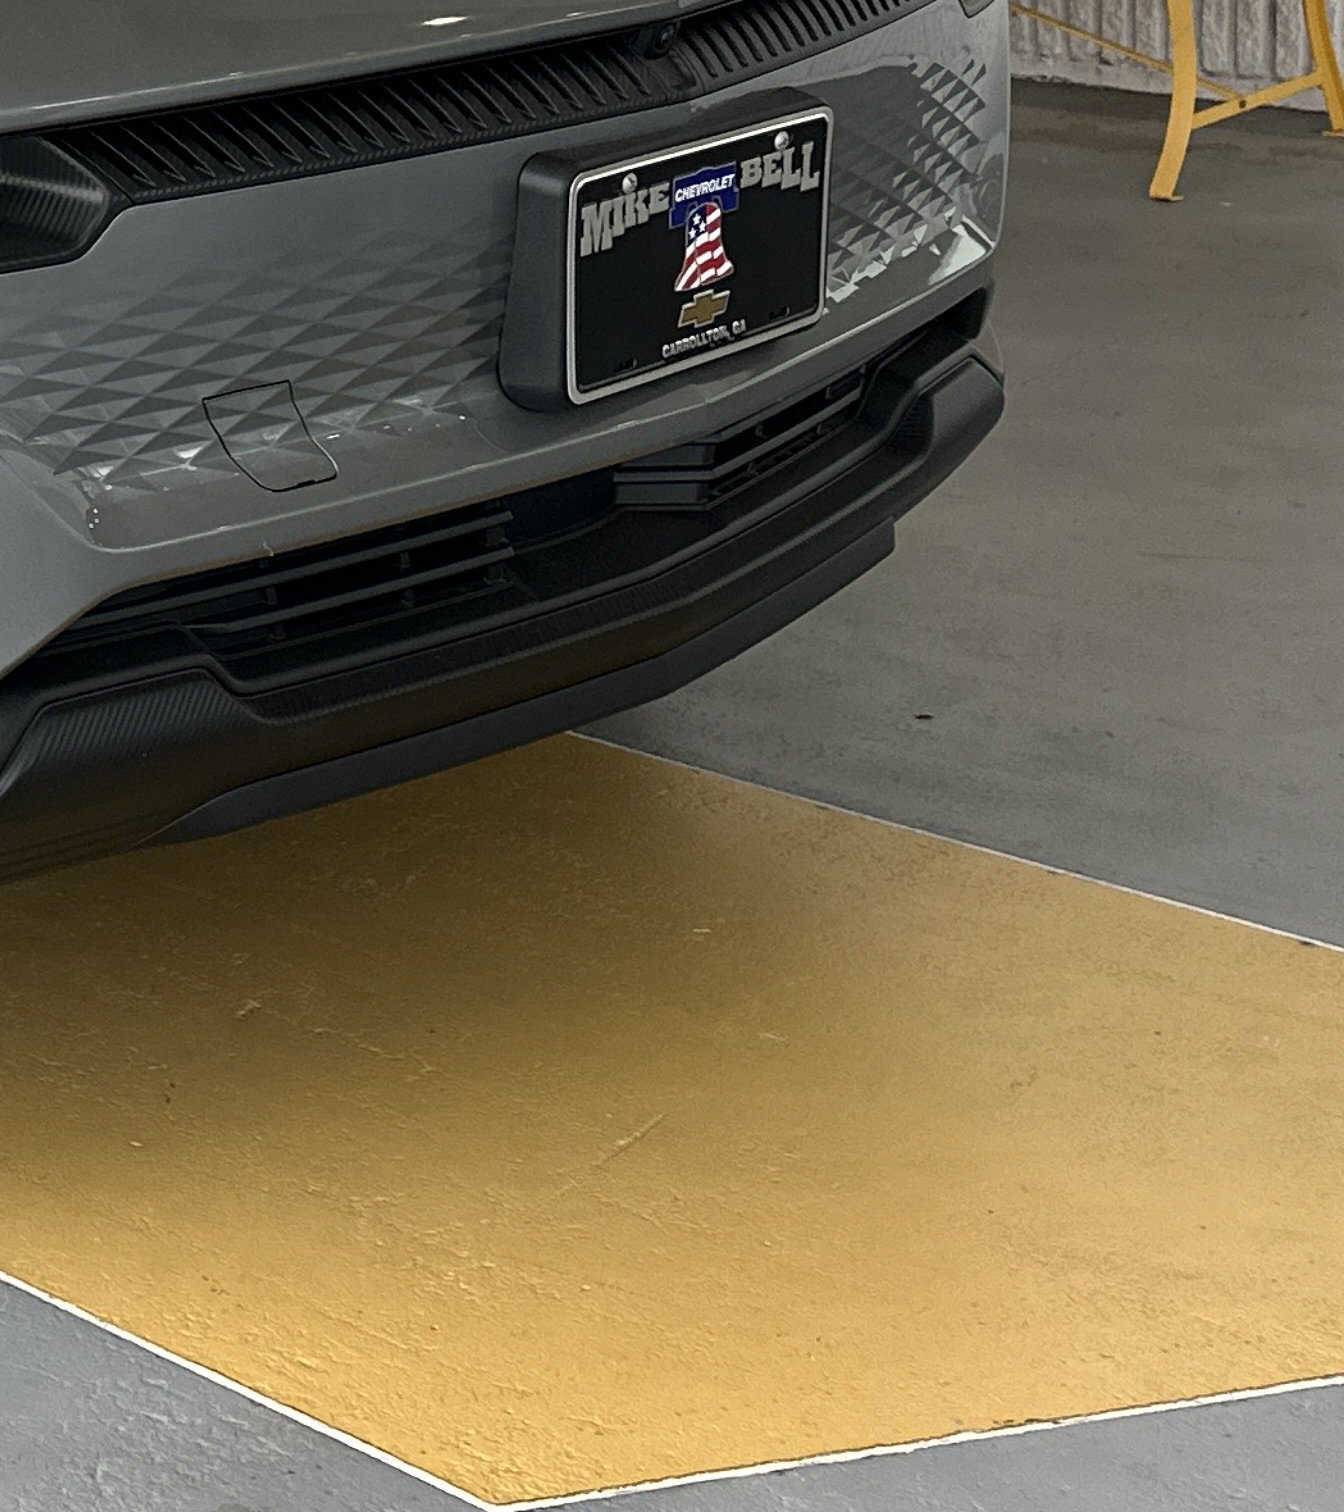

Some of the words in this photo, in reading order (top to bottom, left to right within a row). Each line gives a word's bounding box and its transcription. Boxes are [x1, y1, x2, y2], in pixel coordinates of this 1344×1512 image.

[580, 182, 671, 257] MIKE
[740, 141, 819, 192] BELL
[674, 173, 736, 203] CHEVROLET
[732, 318, 747, 335] GA
